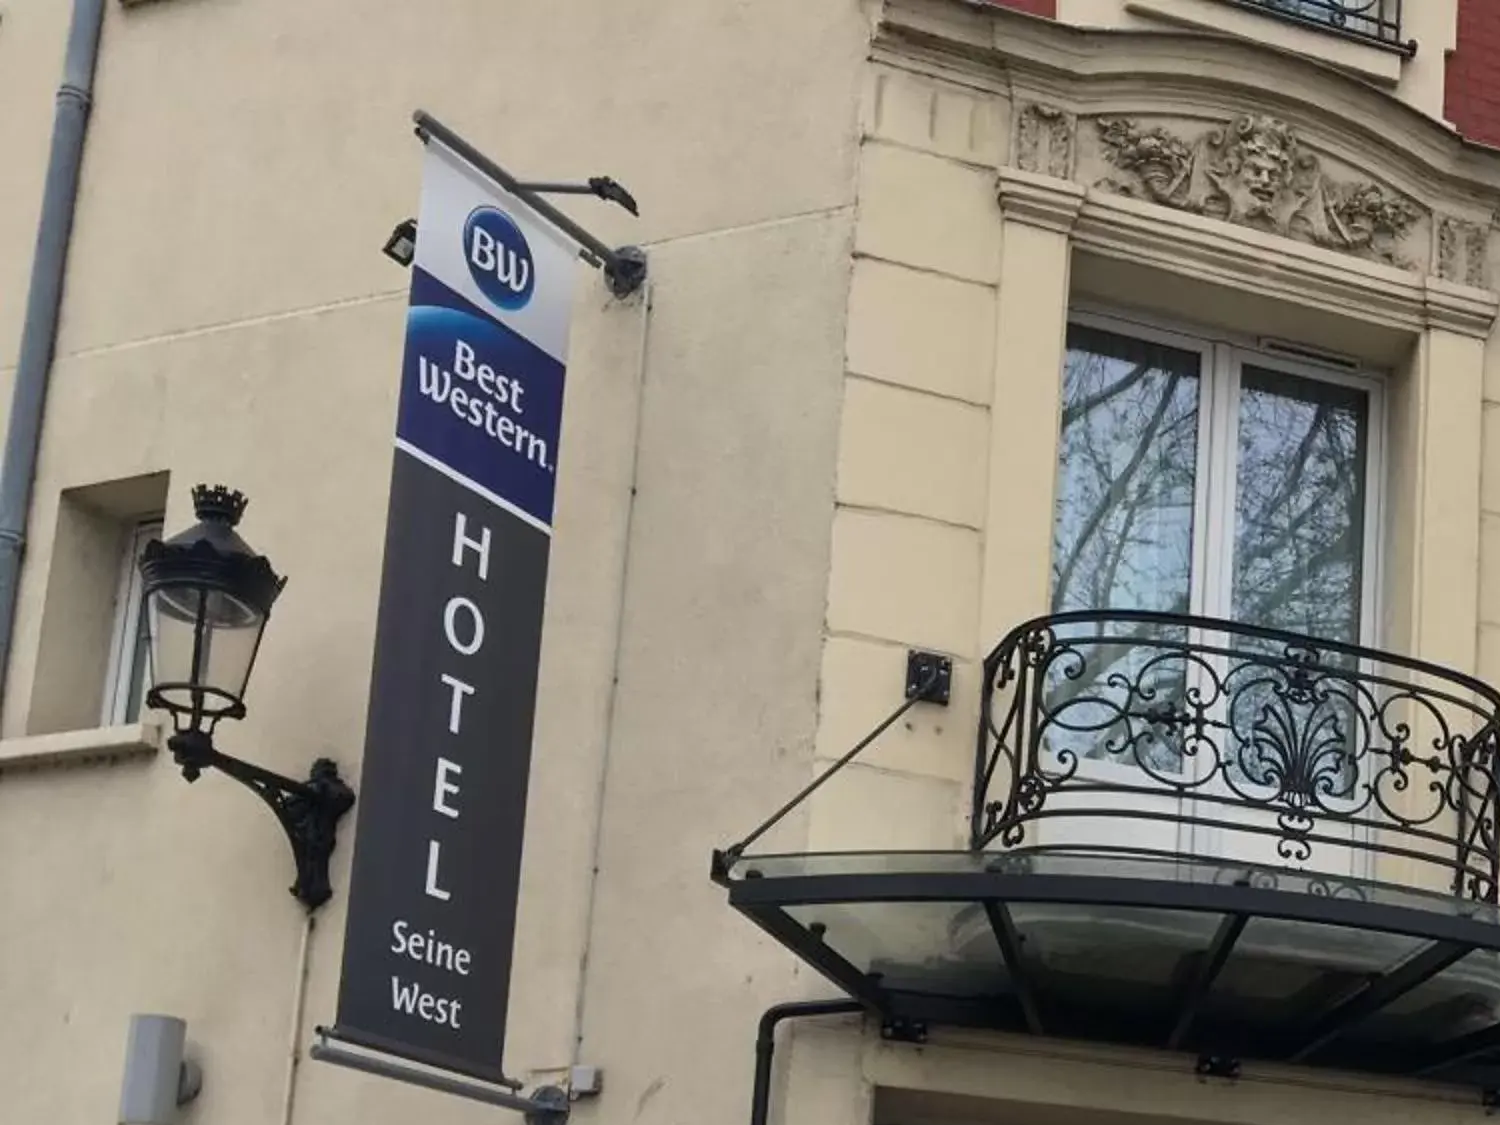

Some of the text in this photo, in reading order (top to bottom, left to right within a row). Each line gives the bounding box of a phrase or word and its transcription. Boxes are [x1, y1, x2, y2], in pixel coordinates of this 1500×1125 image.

[470, 226, 530, 291] BW
[453, 339, 525, 414] Best
[425, 512, 492, 901] HOTEL
[391, 920, 472, 975] Seine
[390, 976, 462, 1029] West
